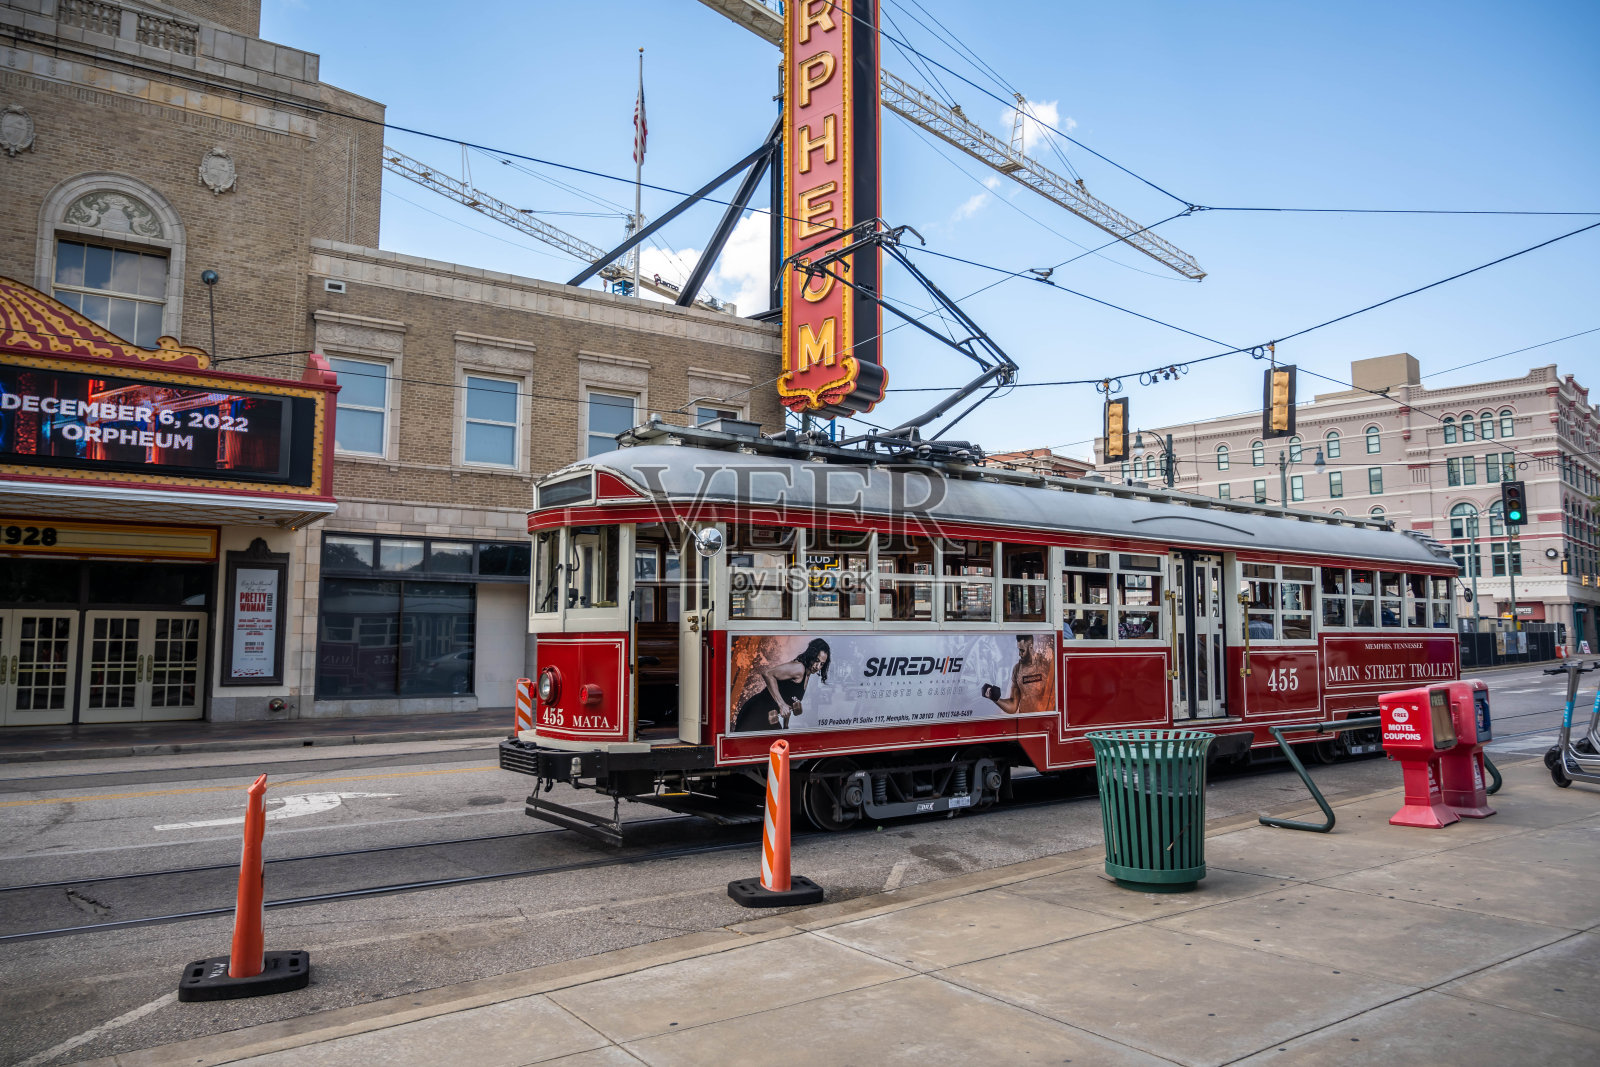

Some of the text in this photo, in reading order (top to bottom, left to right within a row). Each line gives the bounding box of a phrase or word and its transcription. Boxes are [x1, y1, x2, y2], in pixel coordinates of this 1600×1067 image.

[1, 393, 249, 433] DECEMBER 6, 2022
[62, 424, 194, 450] ORPHEUM
[240, 592, 267, 602] PRETTY
[240, 602, 266, 612] WOMAN
[1267, 668, 1299, 692] 455
[1328, 663, 1454, 681] MAIN STREET TROLLEY
[542, 706, 564, 726] 455
[572, 715, 609, 728] MATA
[828, 717, 851, 725] Peabody
[886, 714, 910, 722] Memphis,
